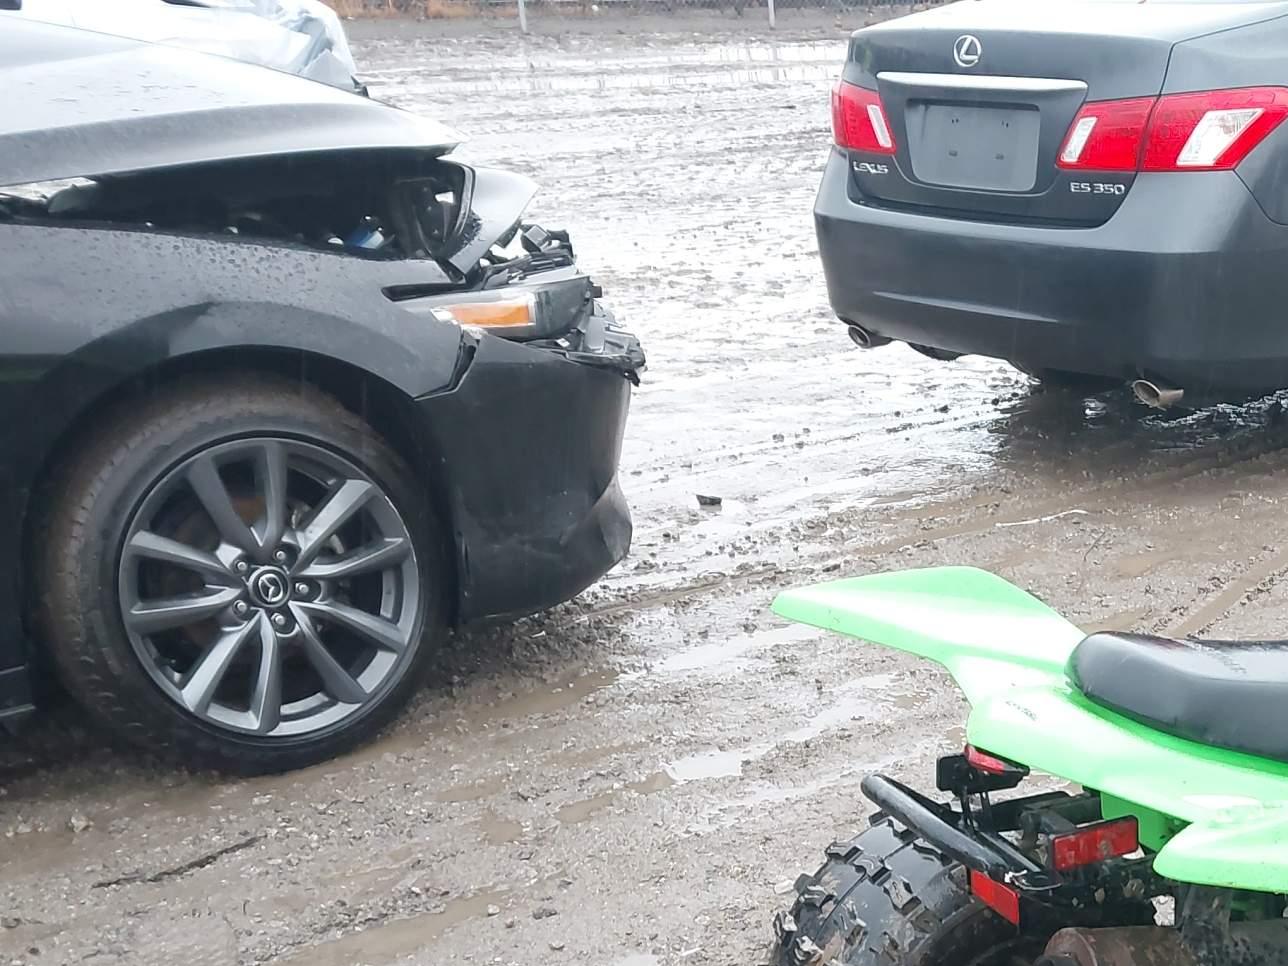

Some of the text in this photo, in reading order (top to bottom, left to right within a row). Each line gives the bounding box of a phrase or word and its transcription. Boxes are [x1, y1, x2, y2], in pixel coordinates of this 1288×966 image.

[853, 161, 889, 174] LEXUS
[1070, 182, 1125, 195] ES 350
